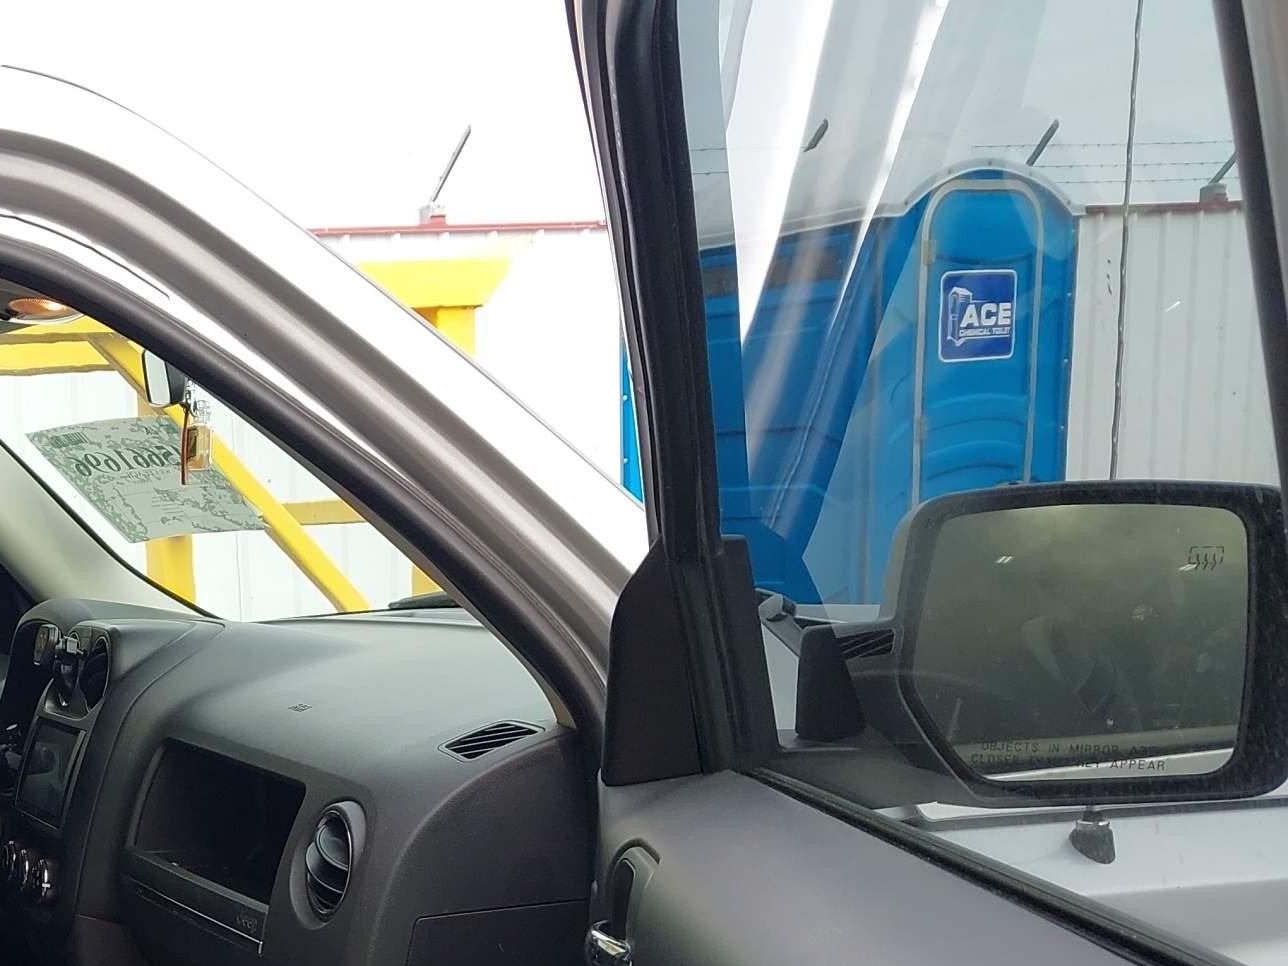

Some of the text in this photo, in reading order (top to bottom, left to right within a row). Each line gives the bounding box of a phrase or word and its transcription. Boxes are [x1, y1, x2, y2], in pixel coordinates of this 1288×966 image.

[960, 303, 1011, 327] ACE
[982, 741, 1040, 753] OBJECTS
[1048, 743, 1060, 753] IN
[1109, 760, 1166, 771] APPEAR
